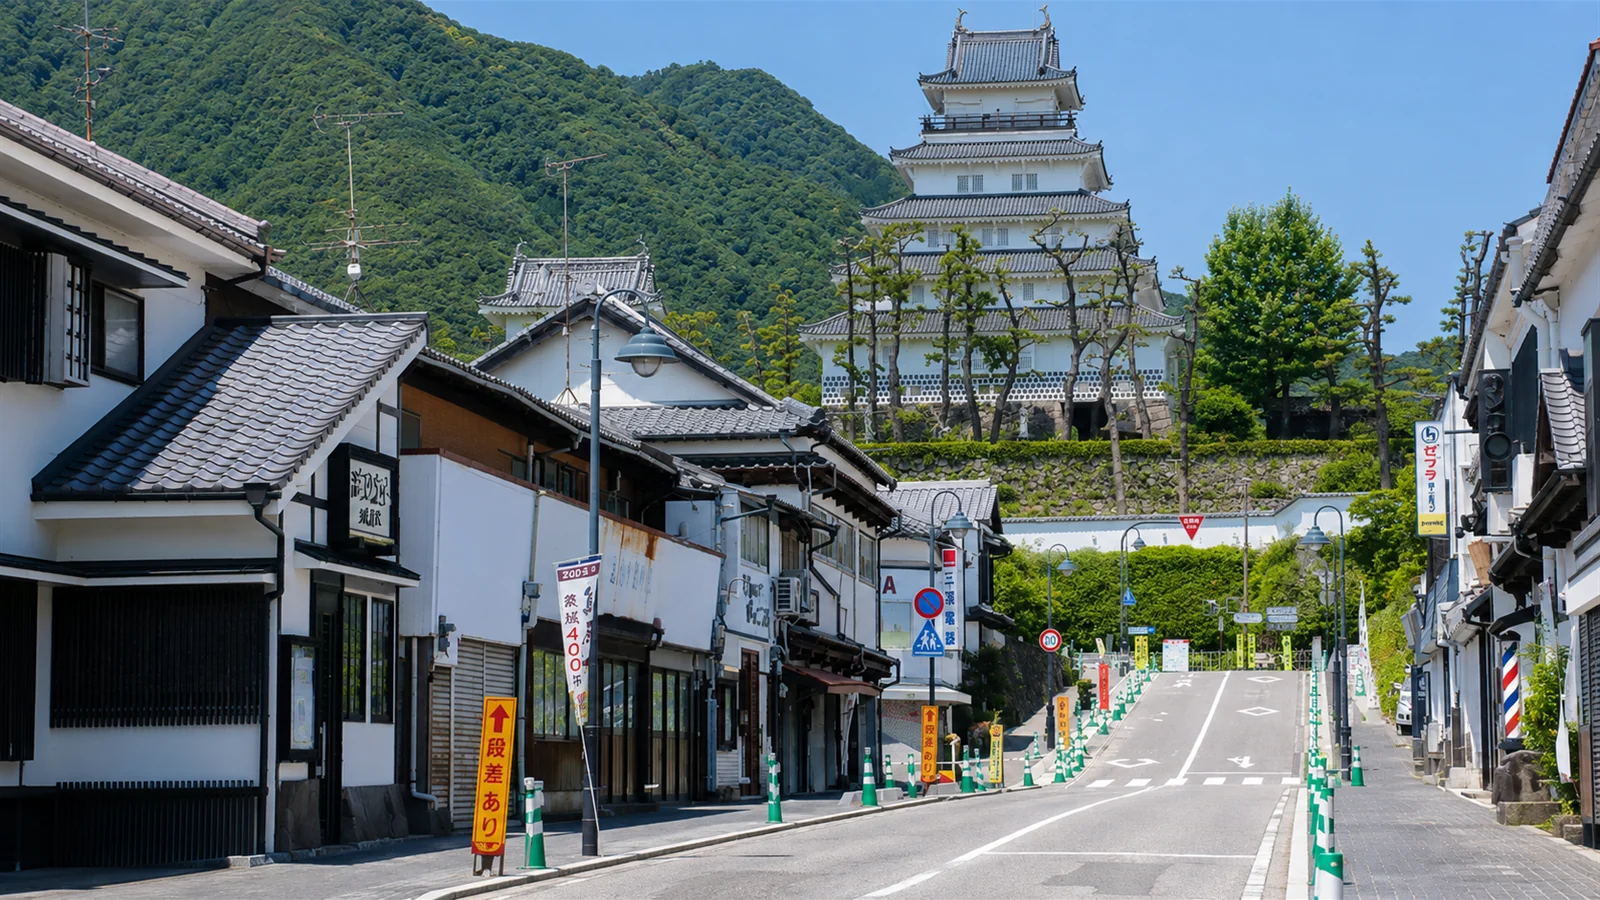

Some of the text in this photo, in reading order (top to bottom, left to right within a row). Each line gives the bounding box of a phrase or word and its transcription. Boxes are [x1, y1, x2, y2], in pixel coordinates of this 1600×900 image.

[882, 575, 897, 594] A
[482, 737, 506, 838] 段差あり
